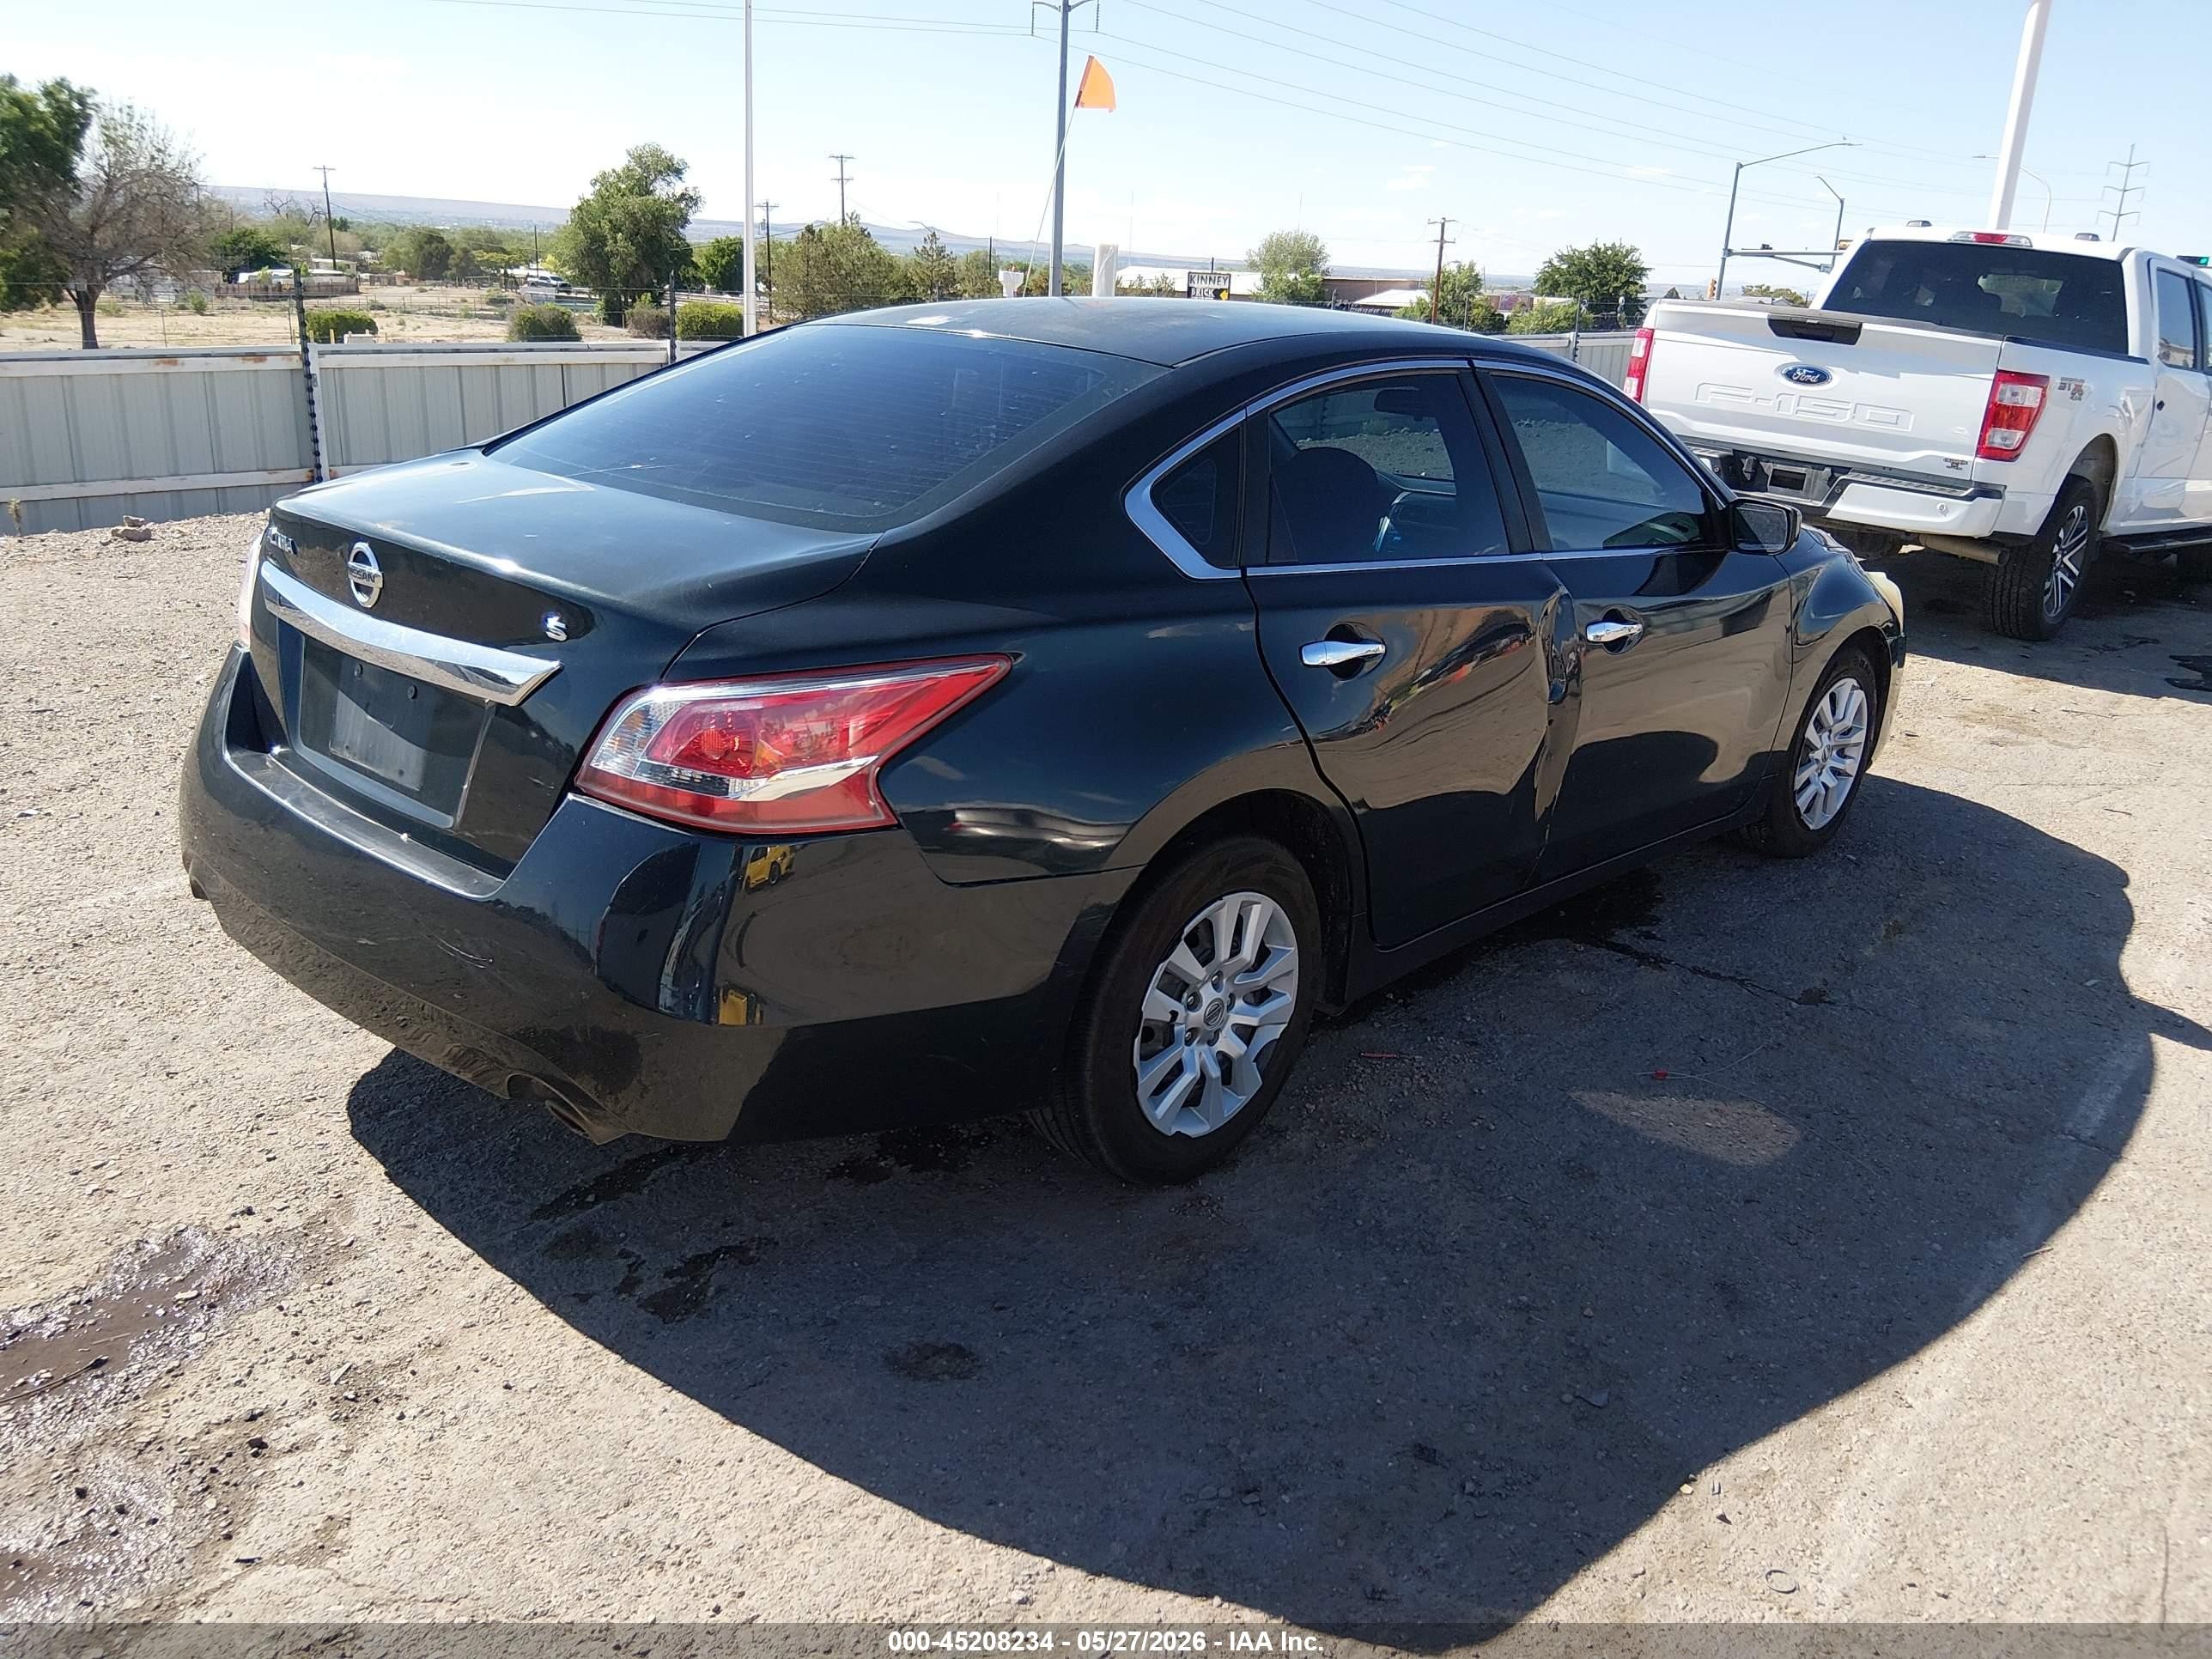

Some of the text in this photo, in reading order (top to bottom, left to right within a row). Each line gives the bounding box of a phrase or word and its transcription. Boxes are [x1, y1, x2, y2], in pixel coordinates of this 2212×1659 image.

[1189, 274, 1228, 286] KINNEY
[1191, 288, 1215, 297] BRICK
[1790, 367, 1820, 385] Ford
[1694, 382, 1915, 432] F-150
[545, 617, 568, 641] S
